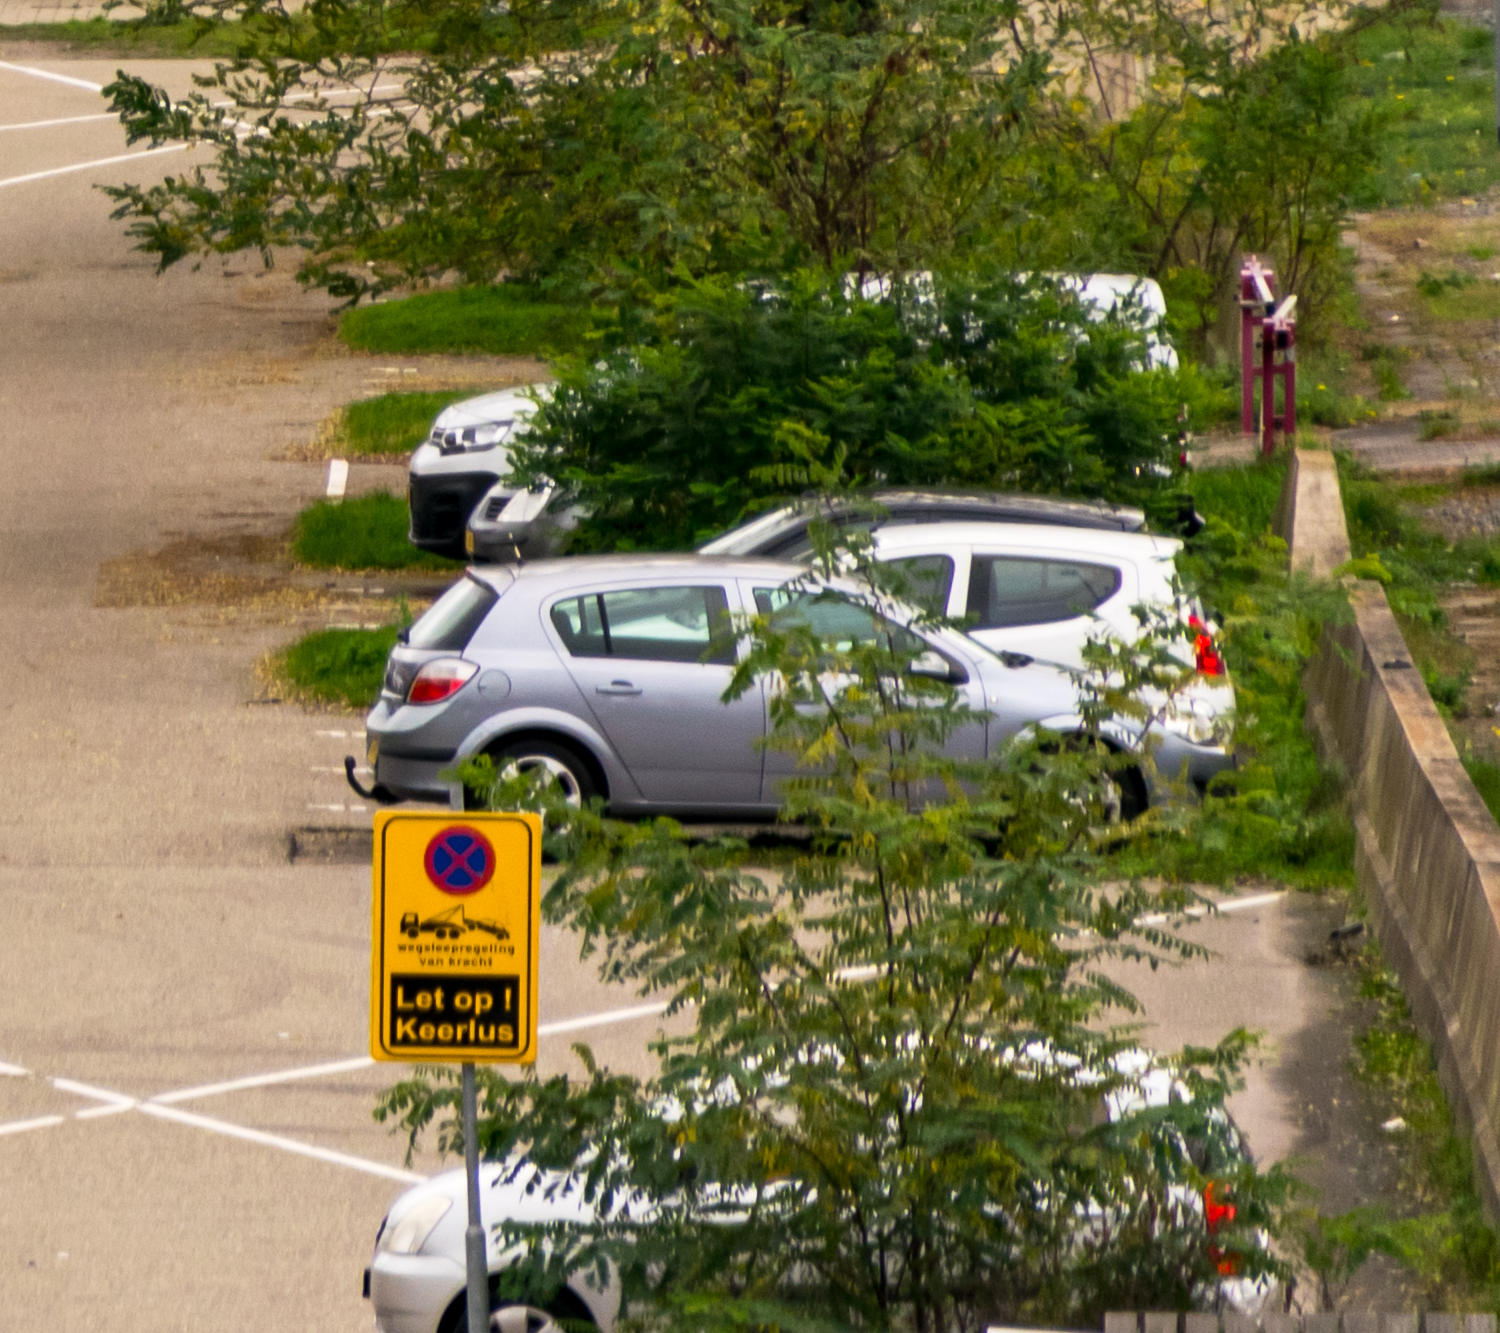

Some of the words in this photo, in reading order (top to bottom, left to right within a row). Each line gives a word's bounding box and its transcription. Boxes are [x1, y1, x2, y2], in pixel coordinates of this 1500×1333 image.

[397, 942, 515, 957] wegsleepregeling
[420, 957, 444, 967] van
[448, 956, 493, 967] kracht
[397, 985, 445, 1011] Let
[454, 989, 493, 1014] op
[396, 1017, 514, 1042] Keerlus
